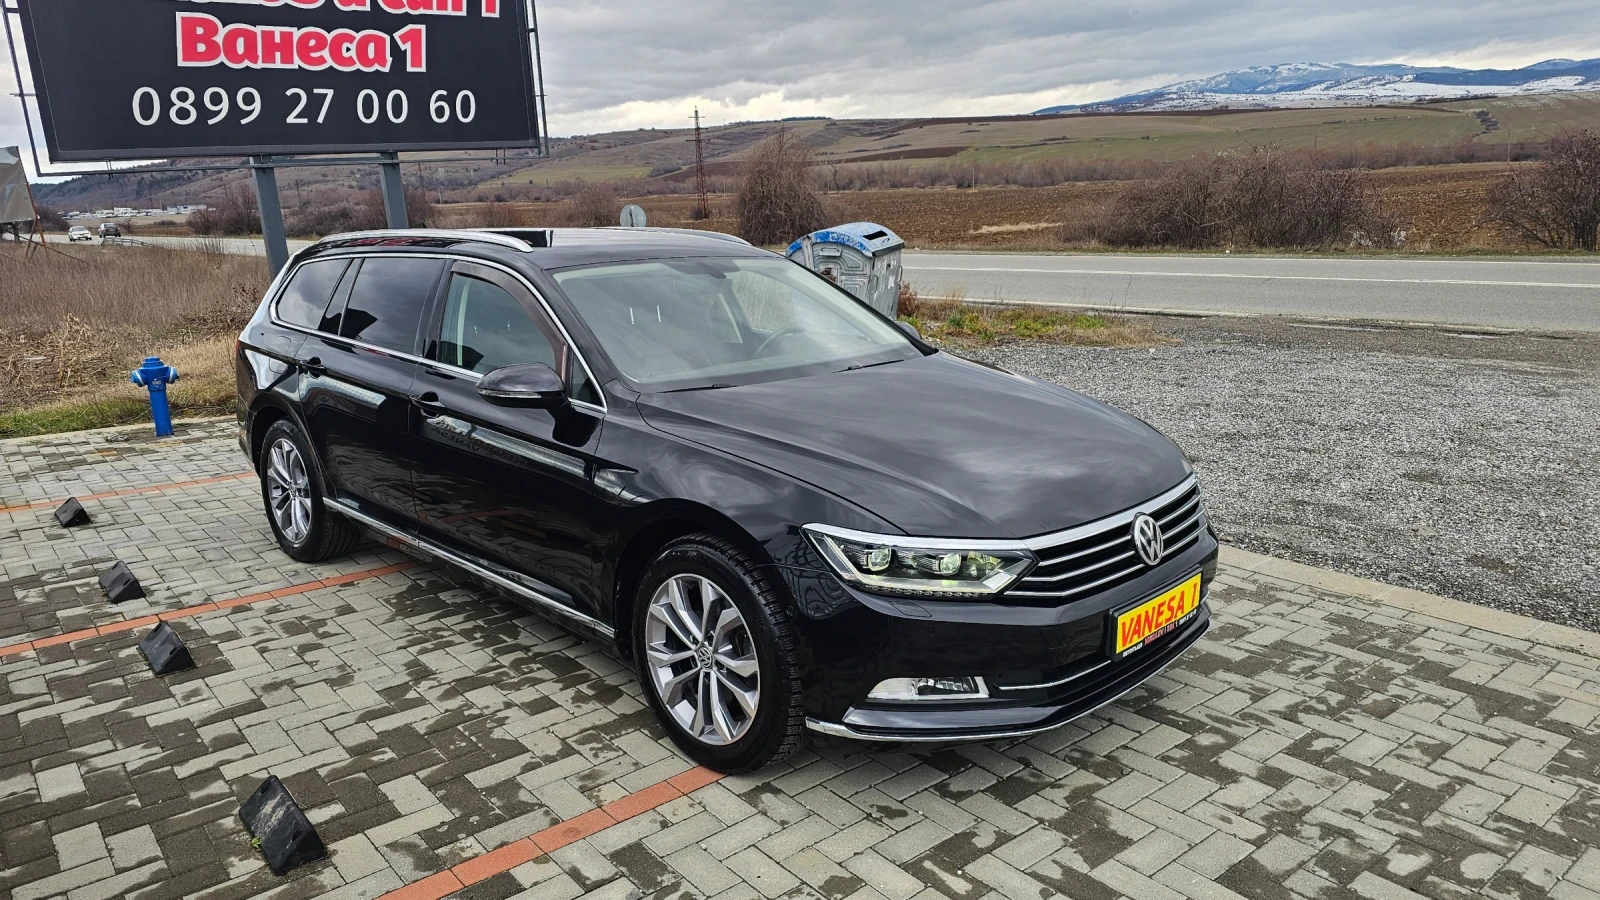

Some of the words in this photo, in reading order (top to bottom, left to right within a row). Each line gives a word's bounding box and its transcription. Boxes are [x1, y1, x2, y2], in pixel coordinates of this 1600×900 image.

[176, 12, 392, 72] Ванеса
[393, 24, 427, 72] 1
[132, 86, 262, 126] 0899
[285, 87, 335, 124] 27
[356, 88, 409, 124] 00
[429, 89, 477, 124] 60
[1135, 515, 1164, 565] VW
[1121, 590, 1185, 648] VANESA
